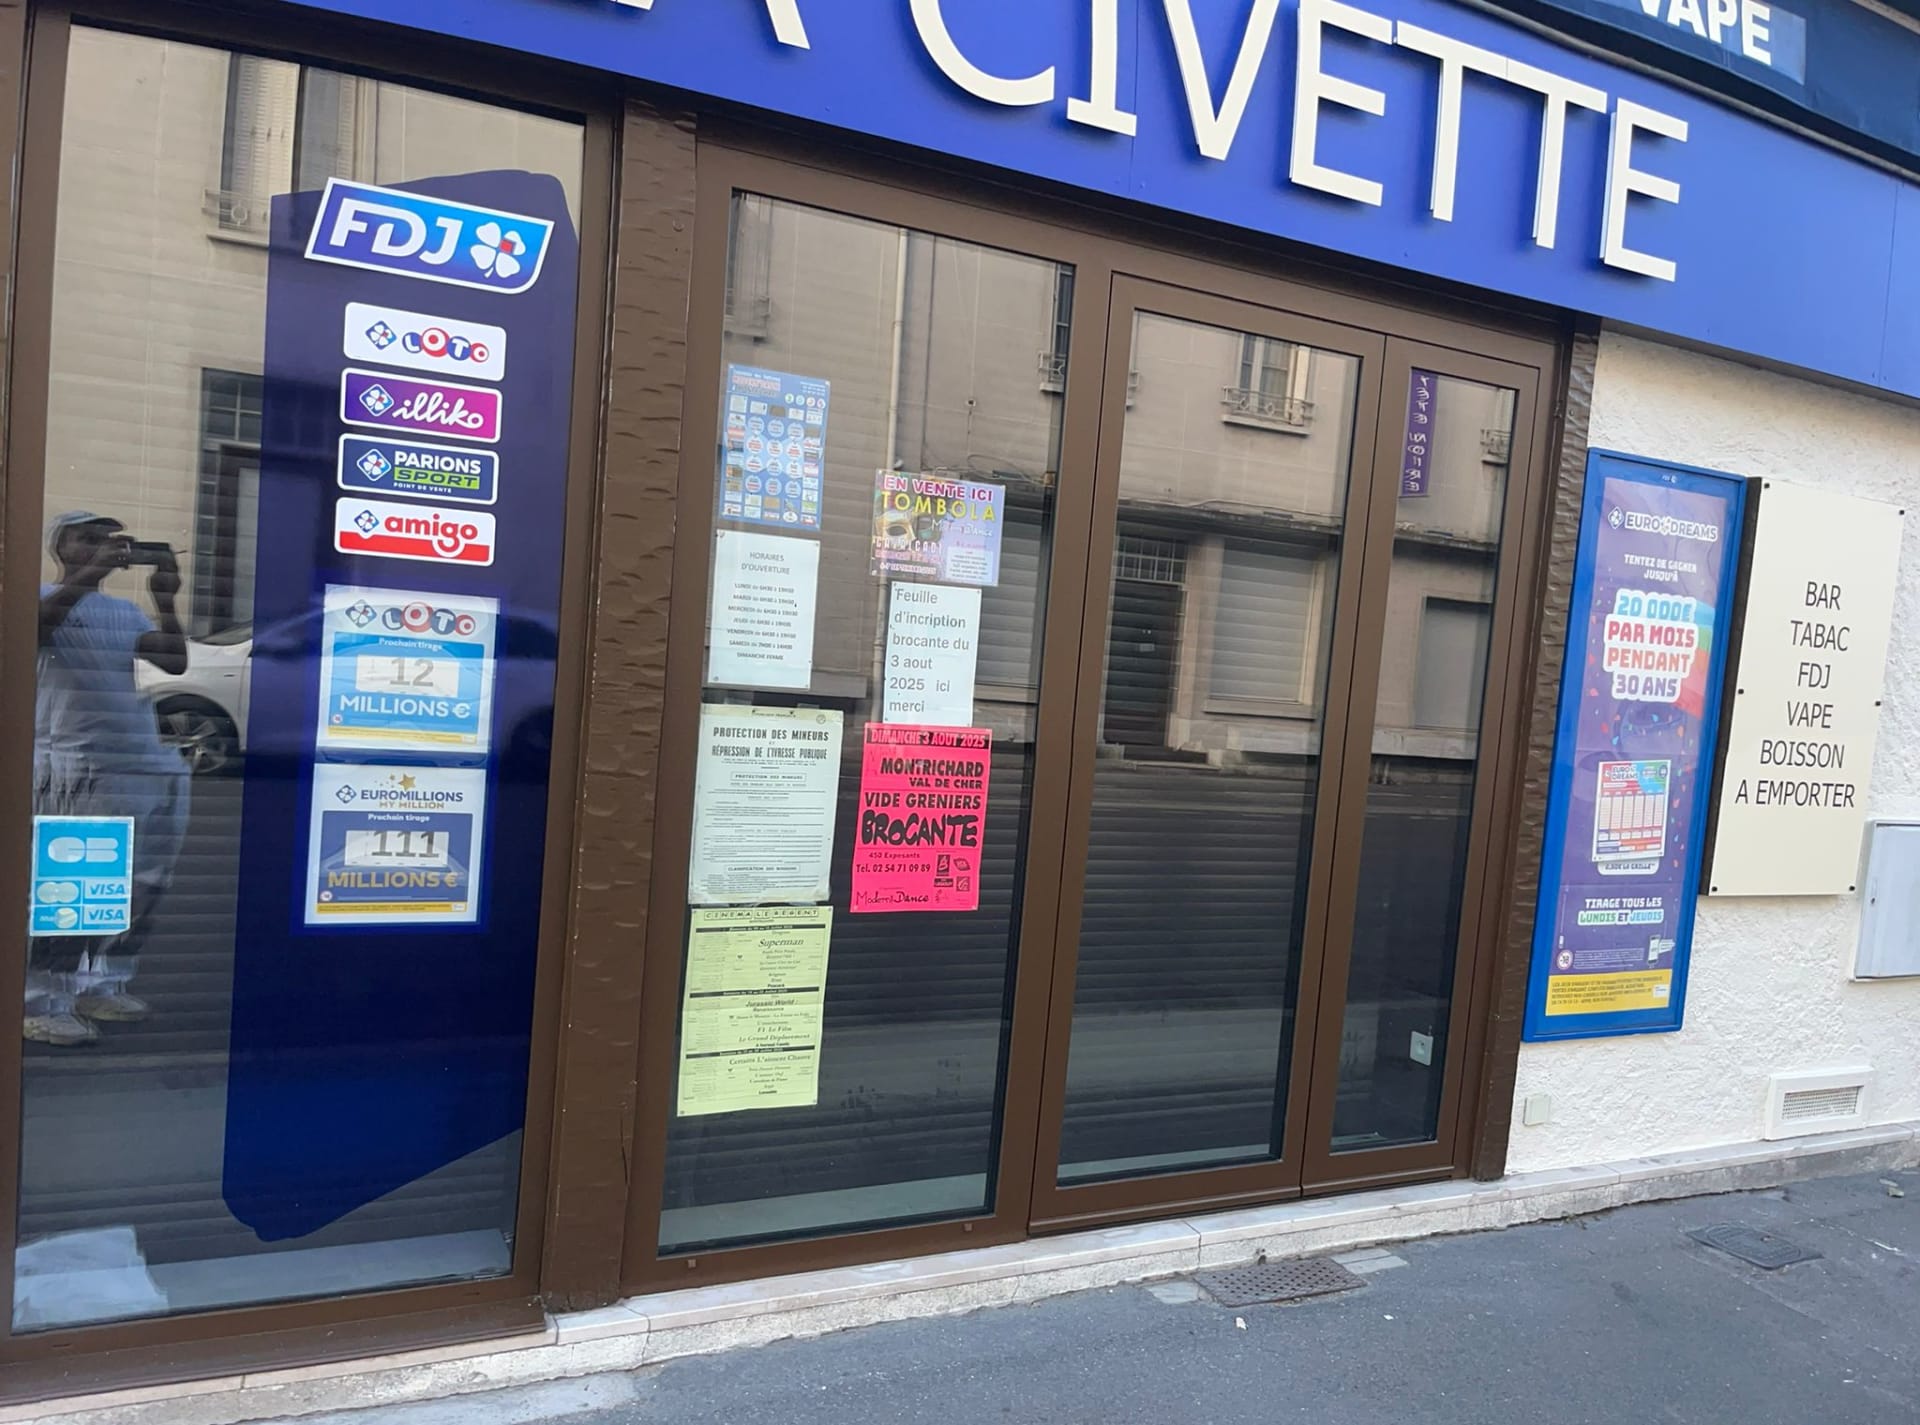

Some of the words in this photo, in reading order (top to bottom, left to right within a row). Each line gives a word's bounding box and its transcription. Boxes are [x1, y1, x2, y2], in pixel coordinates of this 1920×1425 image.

[1640, 0, 1772, 66] APE
[908, 0, 1689, 283] CIVETTE
[329, 197, 463, 267] FDJ
[402, 327, 490, 363] LOTO
[392, 391, 484, 429] illiko
[394, 450, 482, 475] PARIONS
[396, 469, 478, 488] SPORT
[884, 474, 908, 491] EN
[912, 479, 966, 500] VENTE
[970, 487, 993, 502] ICI
[881, 490, 996, 522] TOMBOLA
[384, 513, 478, 554] amigo
[1625, 513, 1661, 531] EURO
[1669, 520, 1717, 541] DREAMS
[749, 551, 785, 562] HORAIRES
[1624, 553, 1656, 568] TENTEZ
[1656, 557, 1668, 570] DE
[1668, 559, 1697, 574] GAGNER
[741, 562, 791, 575] D'OUVERTURE
[895, 588, 938, 604] Feuille
[1805, 581, 1842, 611] BAR
[1617, 595, 1642, 617] 20
[382, 601, 476, 637] LOTO
[894, 611, 966, 629] d'incription
[378, 637, 417, 649] Prochain
[892, 633, 949, 649] brocante
[953, 638, 970, 651] du
[1607, 620, 1645, 643] PAR
[1648, 623, 1695, 649] MOIS
[1790, 620, 1851, 652] TABAC
[890, 654, 900, 668] 3
[903, 658, 933, 670] aout
[1606, 647, 1691, 673] PENDANT
[389, 658, 434, 687] 12
[1797, 662, 1832, 689] FDJ
[889, 676, 925, 691] 2025
[936, 679, 950, 693] ici
[1615, 674, 1640, 695] 30
[1642, 676, 1678, 698] ANS
[339, 695, 449, 718] MILLIONS
[889, 700, 925, 713] merci
[1787, 701, 1834, 729] VAPE
[713, 726, 767, 740] PROTECTION
[771, 729, 787, 740] DES
[791, 730, 829, 741] MINEURS
[871, 729, 921, 746] DIMANCHE
[924, 732, 931, 745] 3
[960, 734, 986, 748] 2025
[712, 744, 751, 757] RÉPRESSION
[754, 747, 763, 758] DE
[767, 747, 795, 759] L'IVRESSE
[799, 748, 827, 760] PUBLIQUE
[1760, 739, 1846, 769] BOISSON
[880, 758, 985, 777] MONTRICHARD
[909, 777, 931, 788] VAL
[935, 779, 950, 789] DE
[953, 780, 983, 790] CHER
[360, 789, 464, 802] EUROMILLIONS
[865, 792, 900, 808] VIDE
[906, 793, 982, 810] GRENIERS
[1735, 779, 1749, 805] A
[1756, 780, 1856, 808] EMPORTER
[379, 801, 395, 809] MY
[399, 801, 445, 810] MILLION
[367, 813, 404, 822] Prochain
[405, 814, 430, 823] tirage
[862, 809, 979, 848] BROCANTE
[371, 830, 440, 858] 111
[884, 852, 921, 860] Exposants
[872, 864, 882, 873] 02
[885, 864, 895, 873] 54
[897, 864, 907, 873] 71
[908, 864, 919, 873] 09
[920, 864, 931, 873] 89
[89, 883, 126, 896] VISA
[327, 871, 441, 889] MILLIONS
[1585, 898, 1620, 909] TIRAGE
[1621, 897, 1645, 908] TOUS
[1646, 897, 1663, 907] LES
[88, 908, 125, 921] VISA
[1579, 911, 1616, 924] LUNDIS
[1617, 912, 1629, 922] ET
[1629, 910, 1663, 922] JEUDIS
[758, 938, 804, 949] Superman
